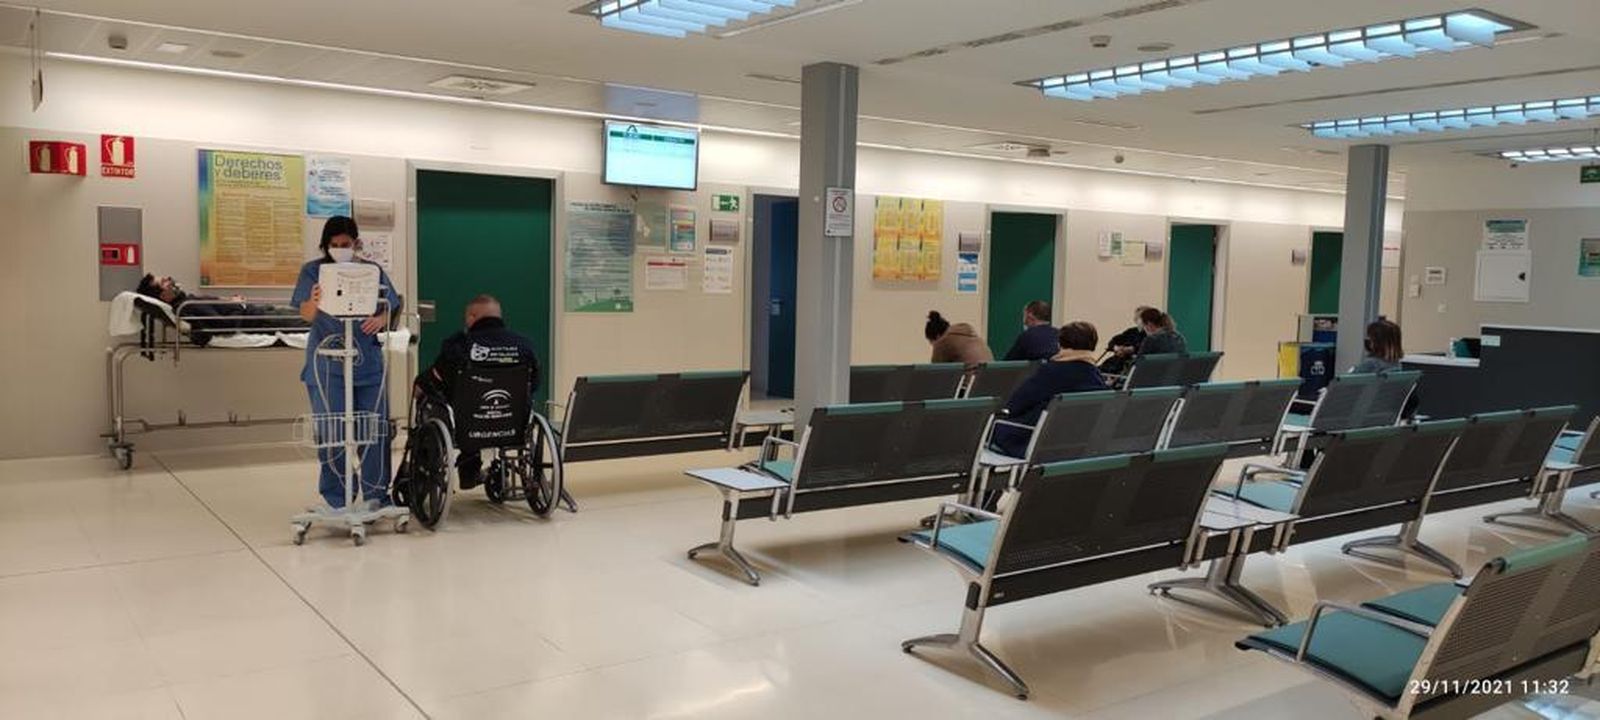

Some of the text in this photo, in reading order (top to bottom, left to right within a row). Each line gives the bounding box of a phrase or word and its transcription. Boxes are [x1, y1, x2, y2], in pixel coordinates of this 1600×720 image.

[214, 153, 283, 171] Derechos
[101, 165, 135, 176] EXTINTOR
[223, 165, 282, 181] deberes
[468, 428, 516, 439] URGENCIAS
